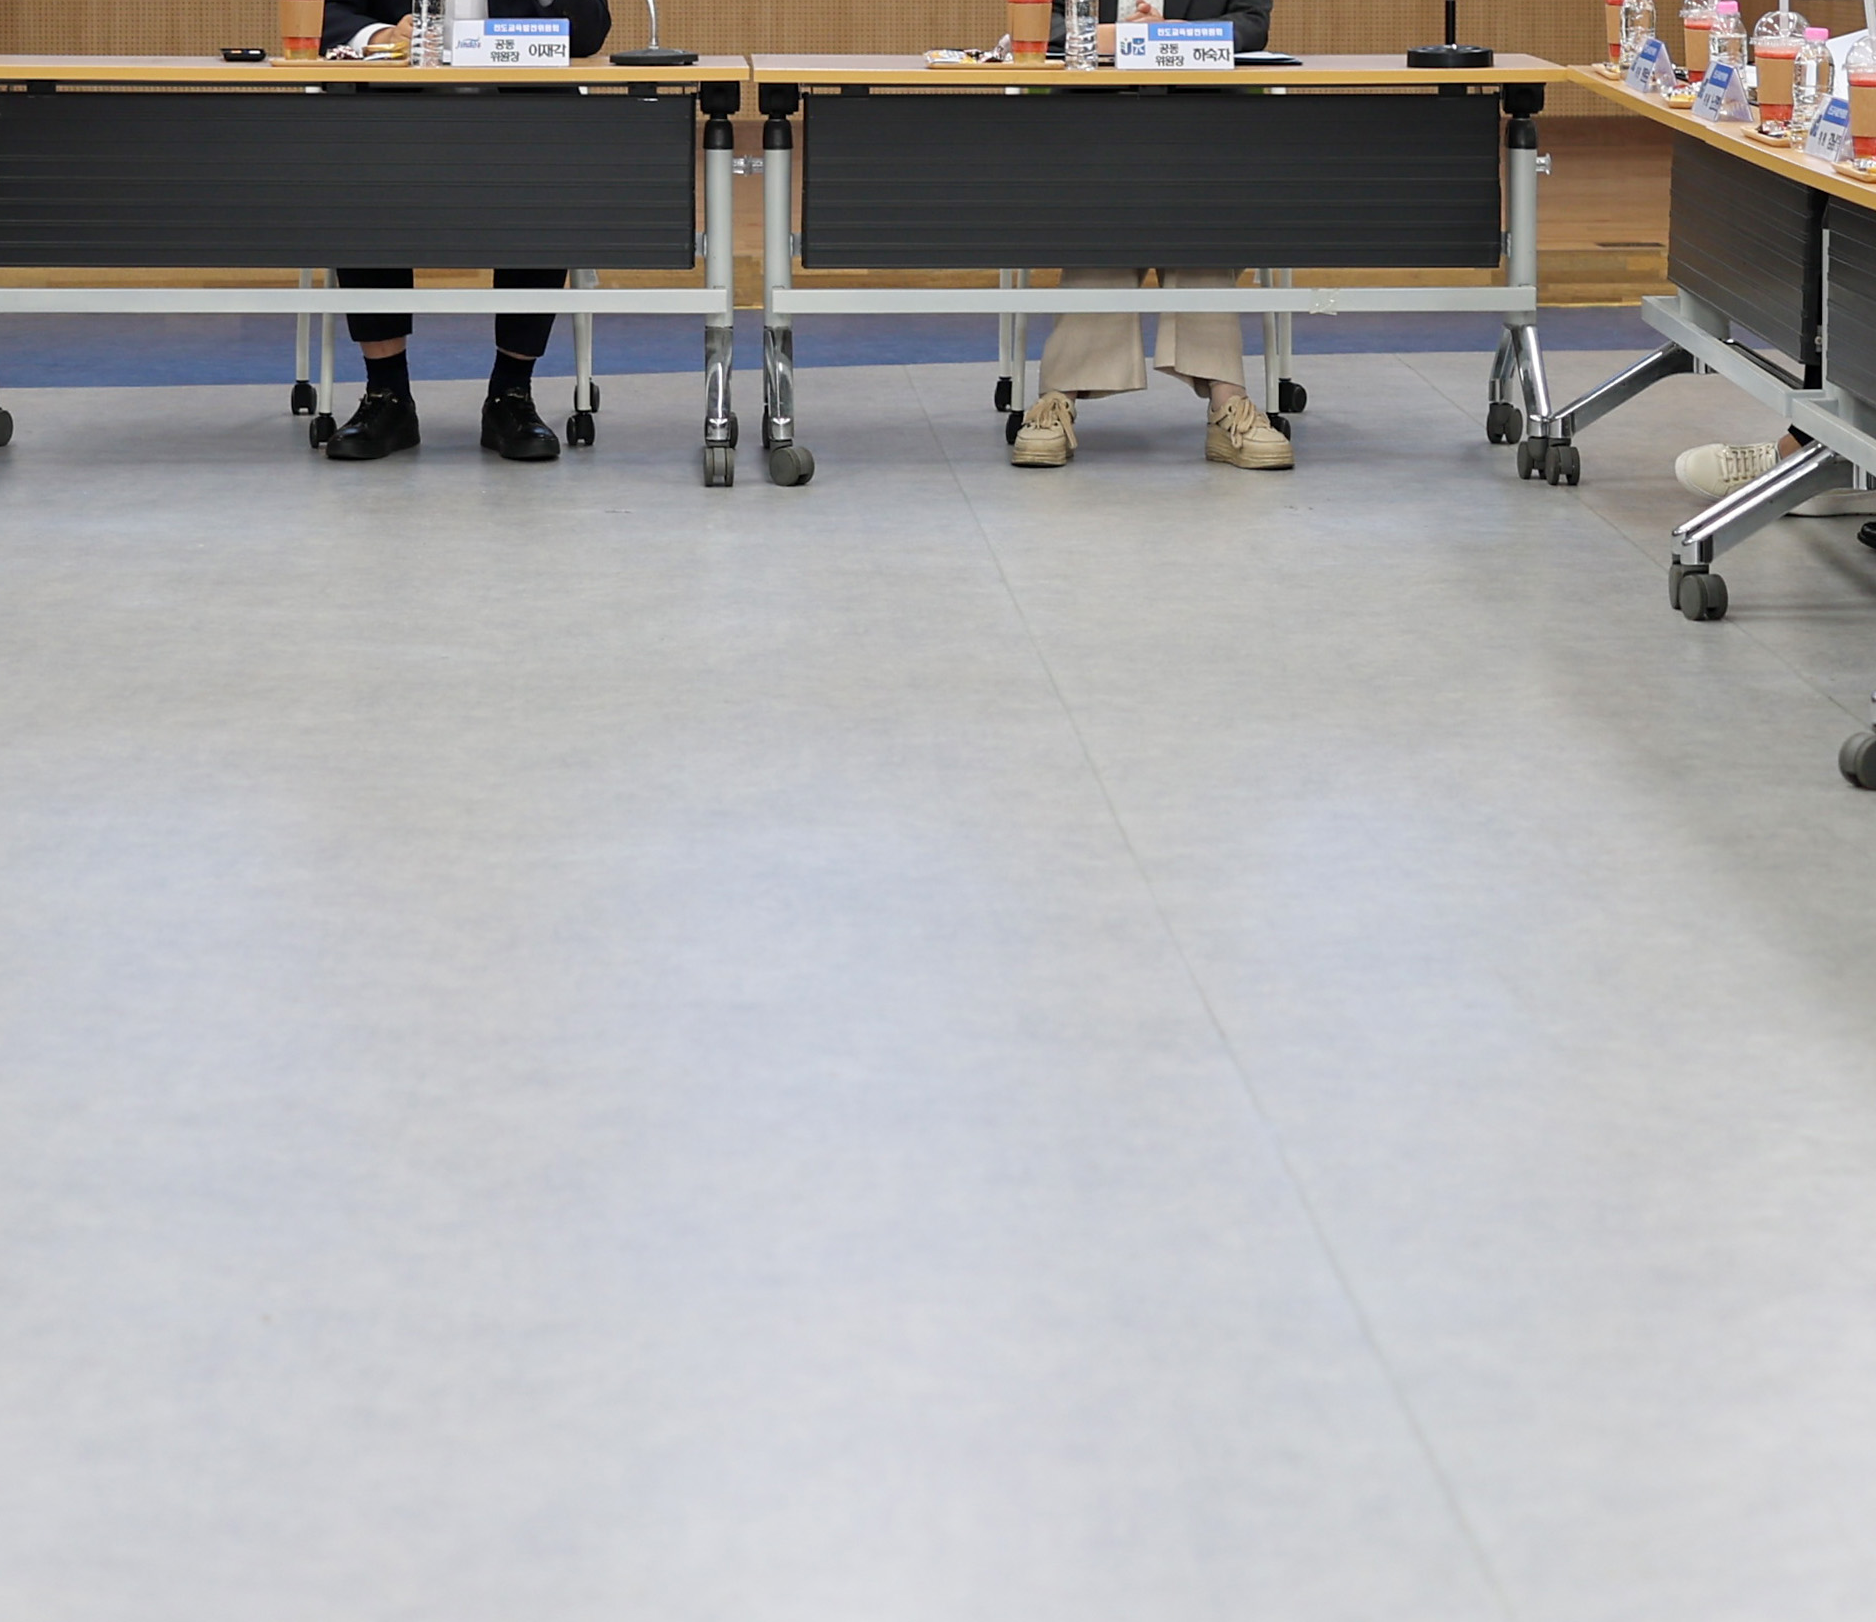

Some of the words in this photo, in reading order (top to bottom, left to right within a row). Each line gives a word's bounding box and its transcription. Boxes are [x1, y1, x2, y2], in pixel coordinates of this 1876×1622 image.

[495, 39, 515, 50] 공동
[528, 43, 567, 58] 이재각
[1159, 43, 1179, 55] 공동
[490, 51, 520, 63] 위원장
[1193, 47, 1231, 62] 하숙자
[1155, 56, 1184, 67] 위원장
